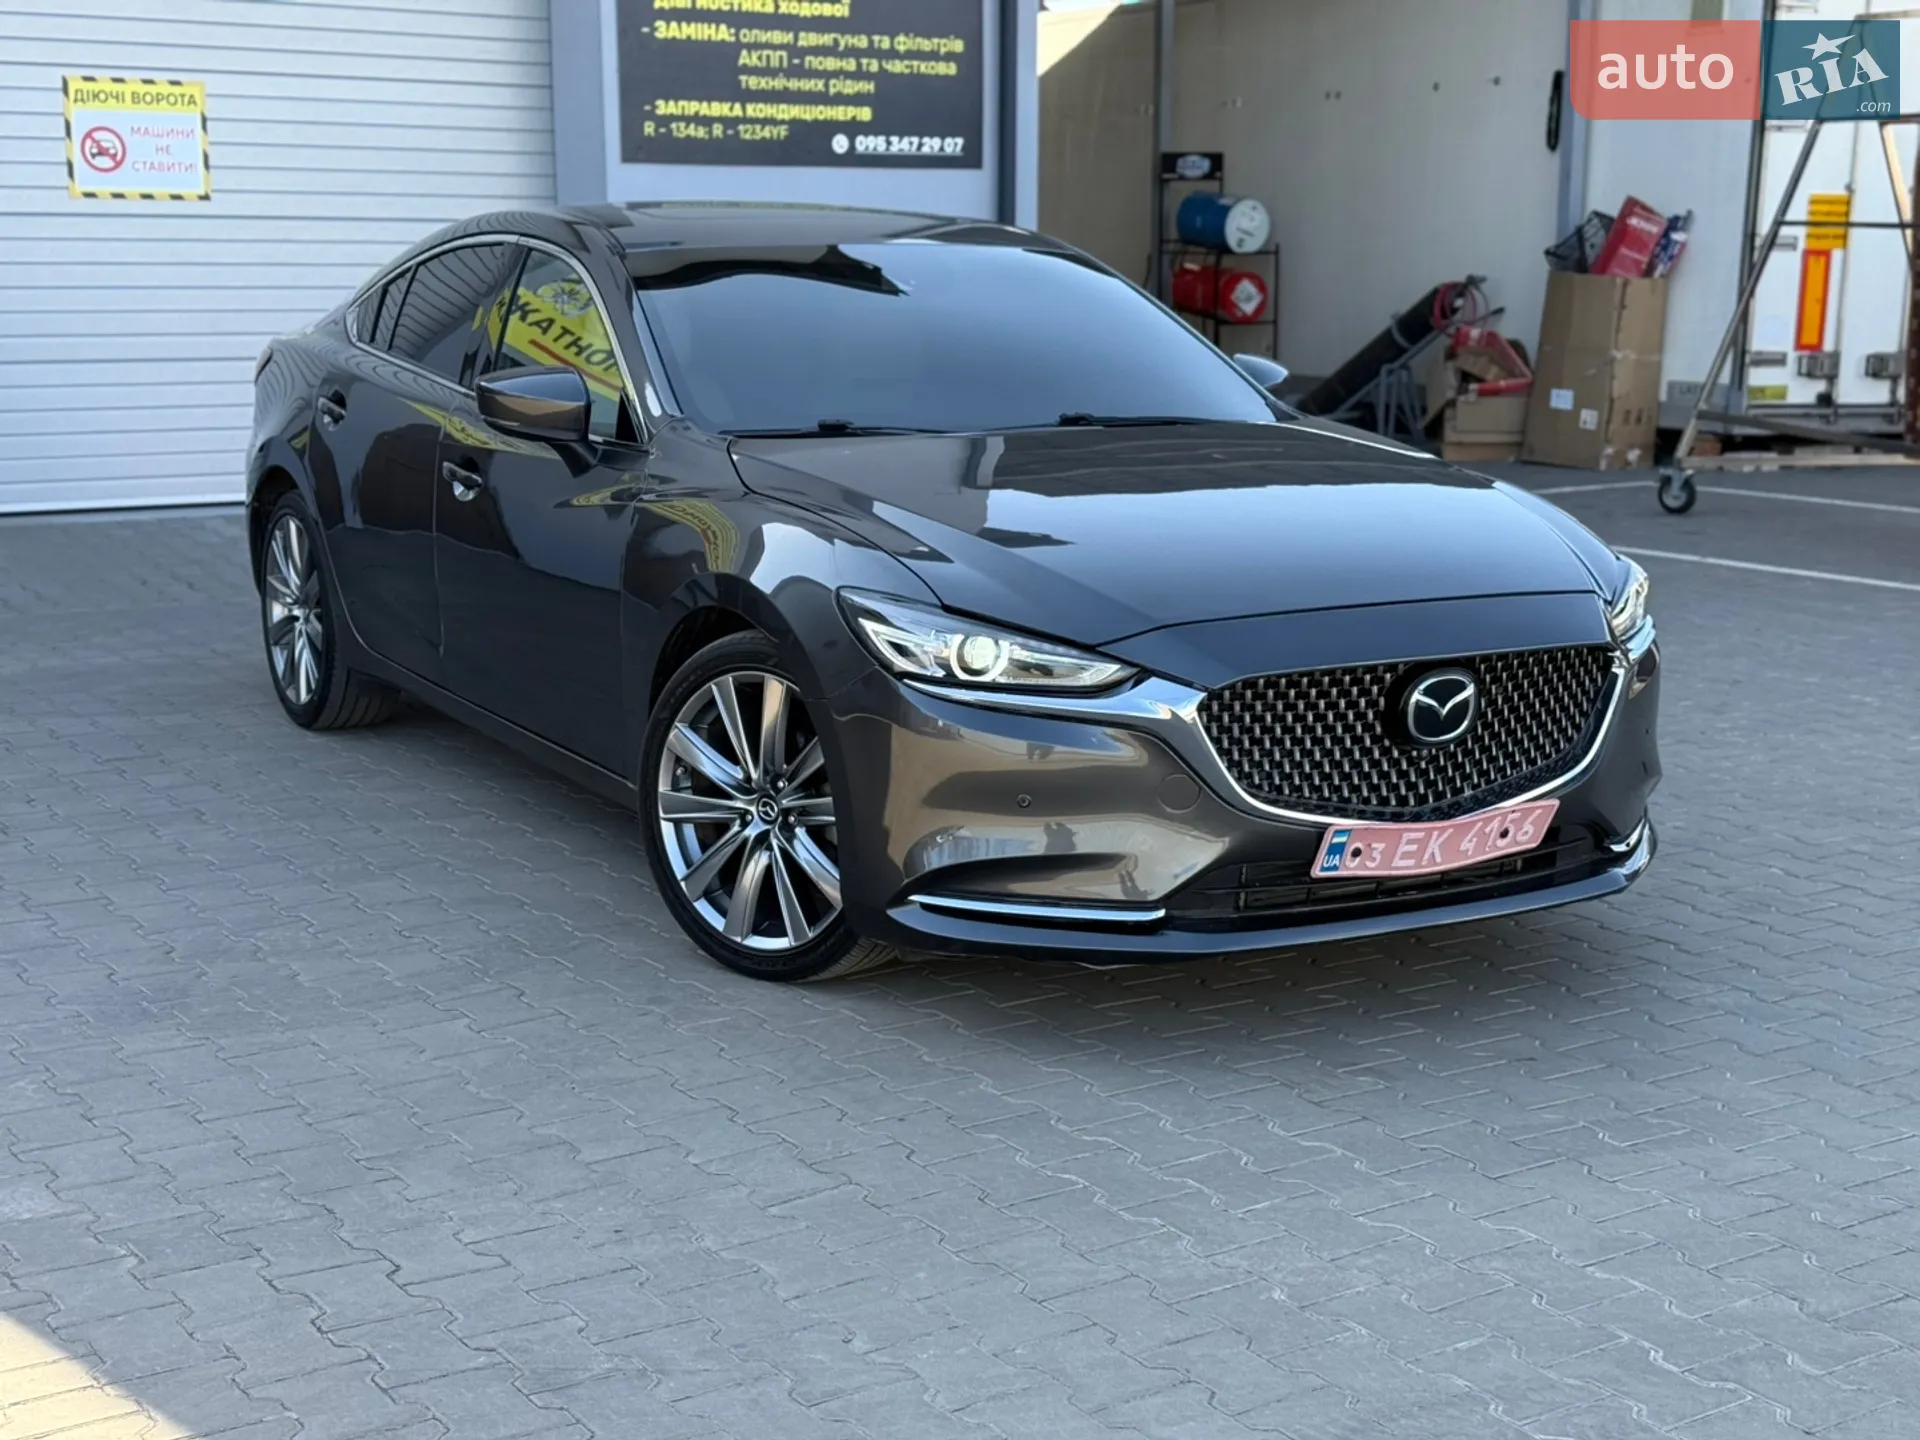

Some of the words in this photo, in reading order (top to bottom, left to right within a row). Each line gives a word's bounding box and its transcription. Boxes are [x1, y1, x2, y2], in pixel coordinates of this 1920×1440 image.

[778, 0, 850, 18] ходової
[653, 20, 736, 42] ЗАМІНА:
[738, 28, 794, 45] оливи
[797, 31, 868, 51] двигуна
[872, 34, 890, 50] та
[893, 33, 965, 56] фільтрів
[737, 49, 788, 69] АКПП
[804, 55, 857, 72] повна
[860, 57, 879, 73] та
[882, 59, 957, 76] часткова
[738, 72, 826, 93] технічних
[828, 74, 875, 97] рідин
[73, 89, 126, 104] ДІЮЧІ
[130, 91, 198, 107] ВОРОТА
[654, 99, 744, 117] ЗАПРАВКА
[745, 102, 873, 122] КОНДИЦІОНЕРІВ
[130, 126, 196, 139] МАШИНИ
[643, 120, 656, 137] R
[712, 123, 724, 139] R
[737, 124, 790, 141] 1234YF
[155, 144, 172, 156] НЕ
[854, 134, 887, 152] 095
[888, 136, 920, 153] 347
[920, 137, 942, 154] 29
[942, 137, 965, 154] 07
[131, 161, 198, 173] СТАВИТИ!
[1345, 842, 1386, 868] 03
[1459, 808, 1543, 857] 4156
[1323, 854, 1340, 867] UA
